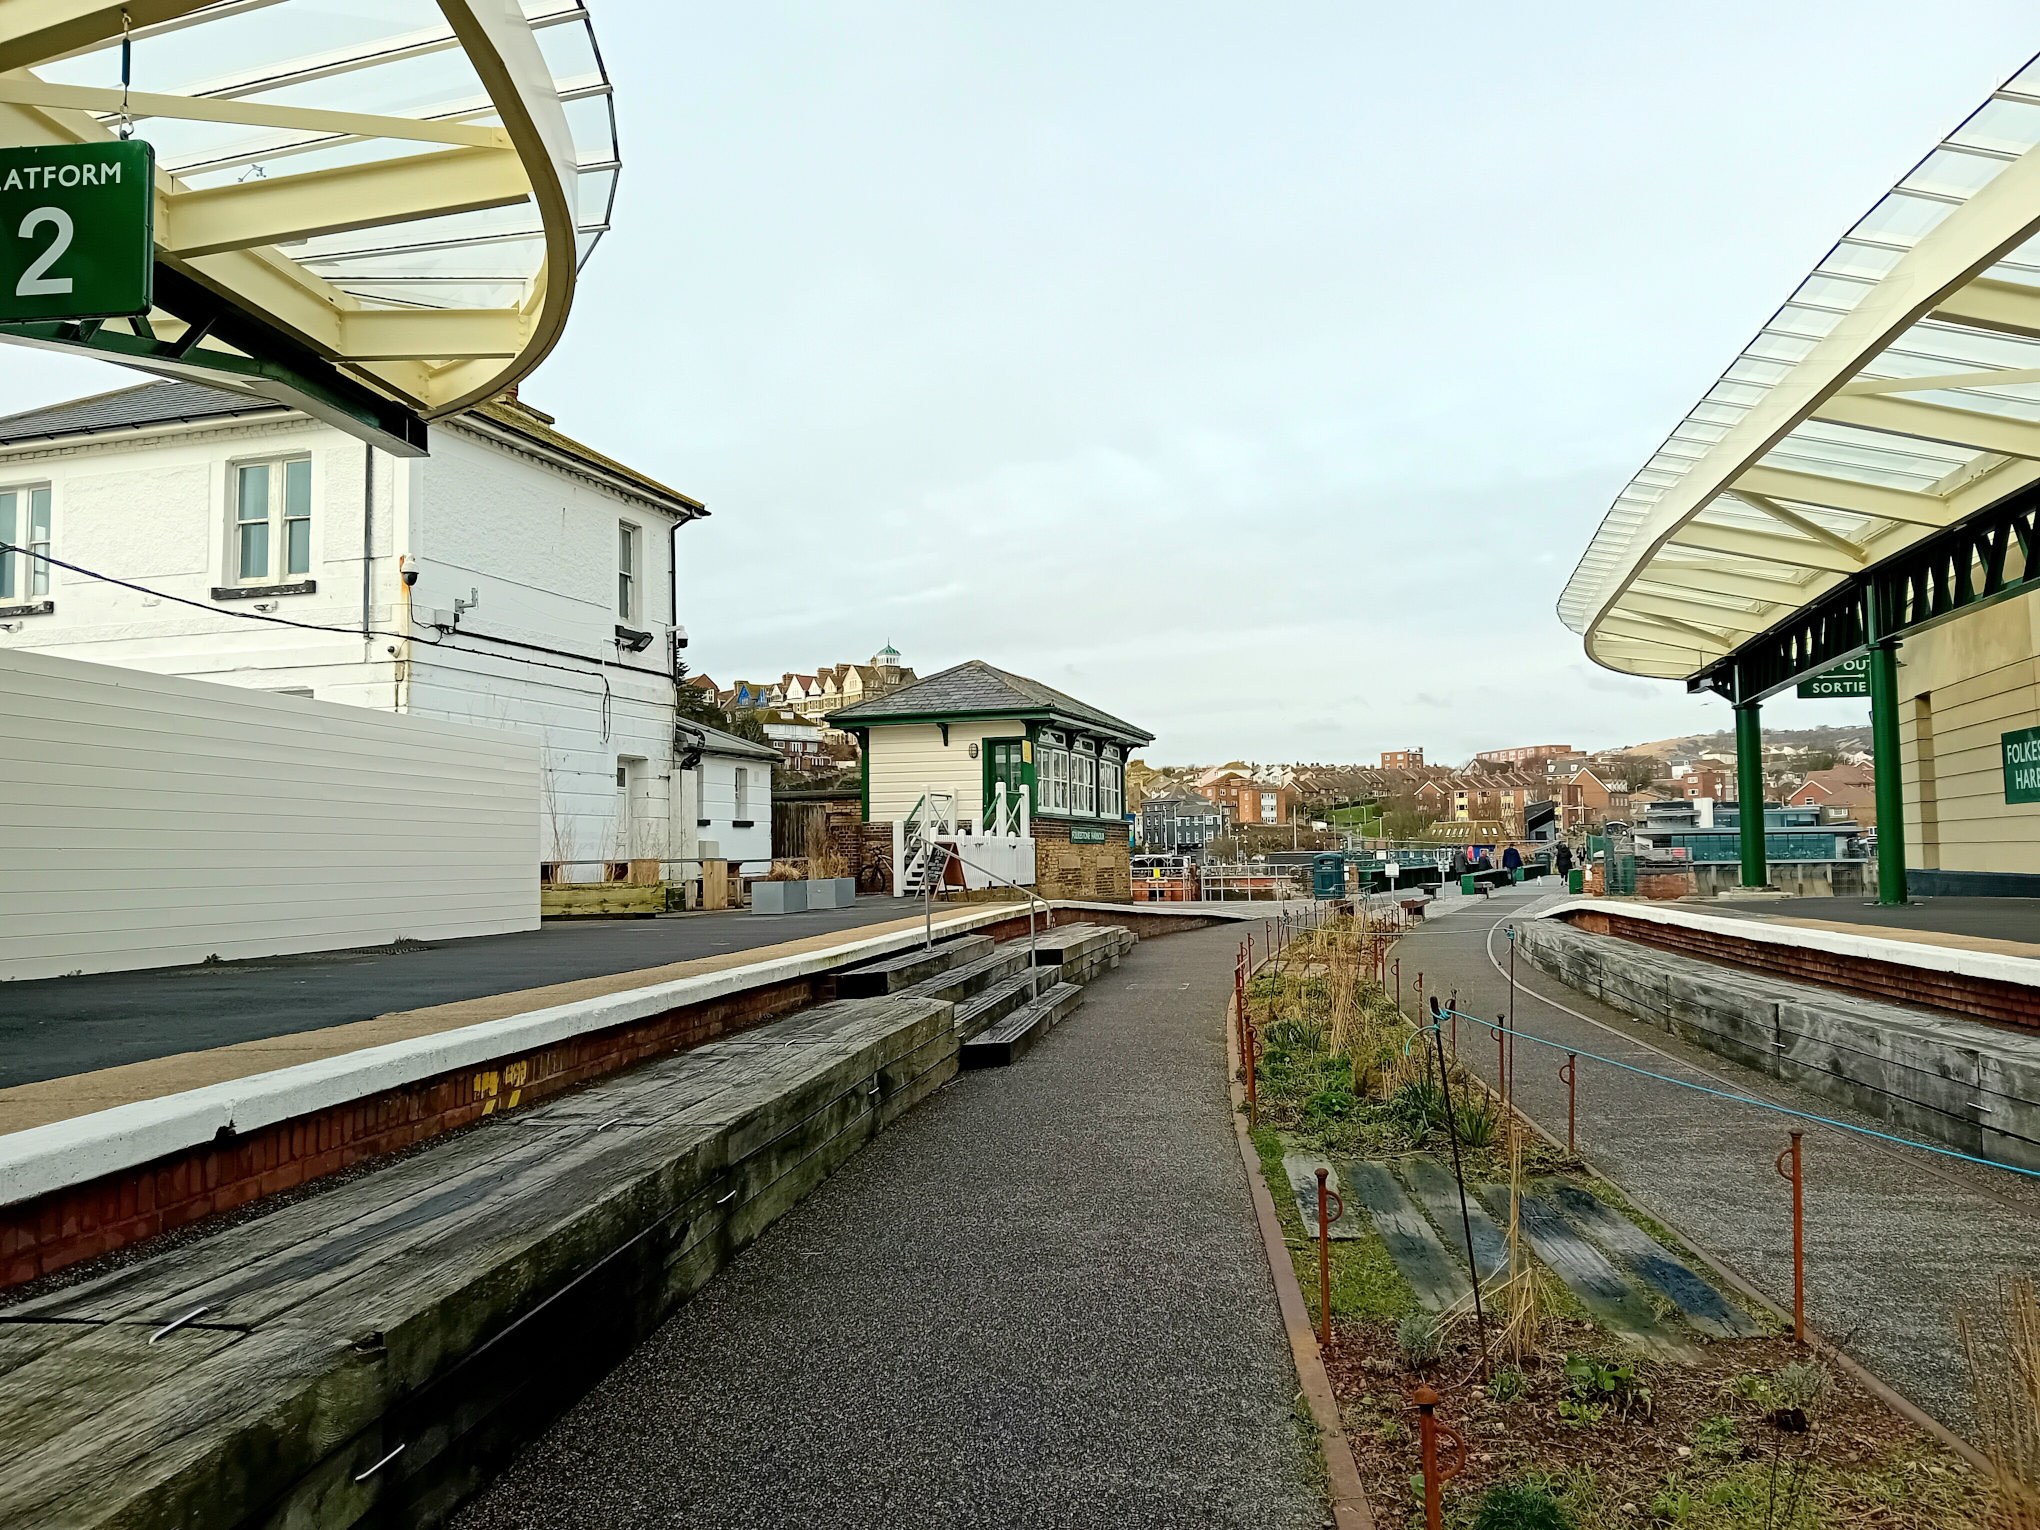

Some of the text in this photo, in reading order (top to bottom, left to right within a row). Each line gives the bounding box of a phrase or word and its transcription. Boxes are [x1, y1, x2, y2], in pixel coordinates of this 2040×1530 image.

[0, 161, 122, 191] ATFORM
[15, 206, 74, 296] 2
[1812, 681, 1867, 694] SORTIE
